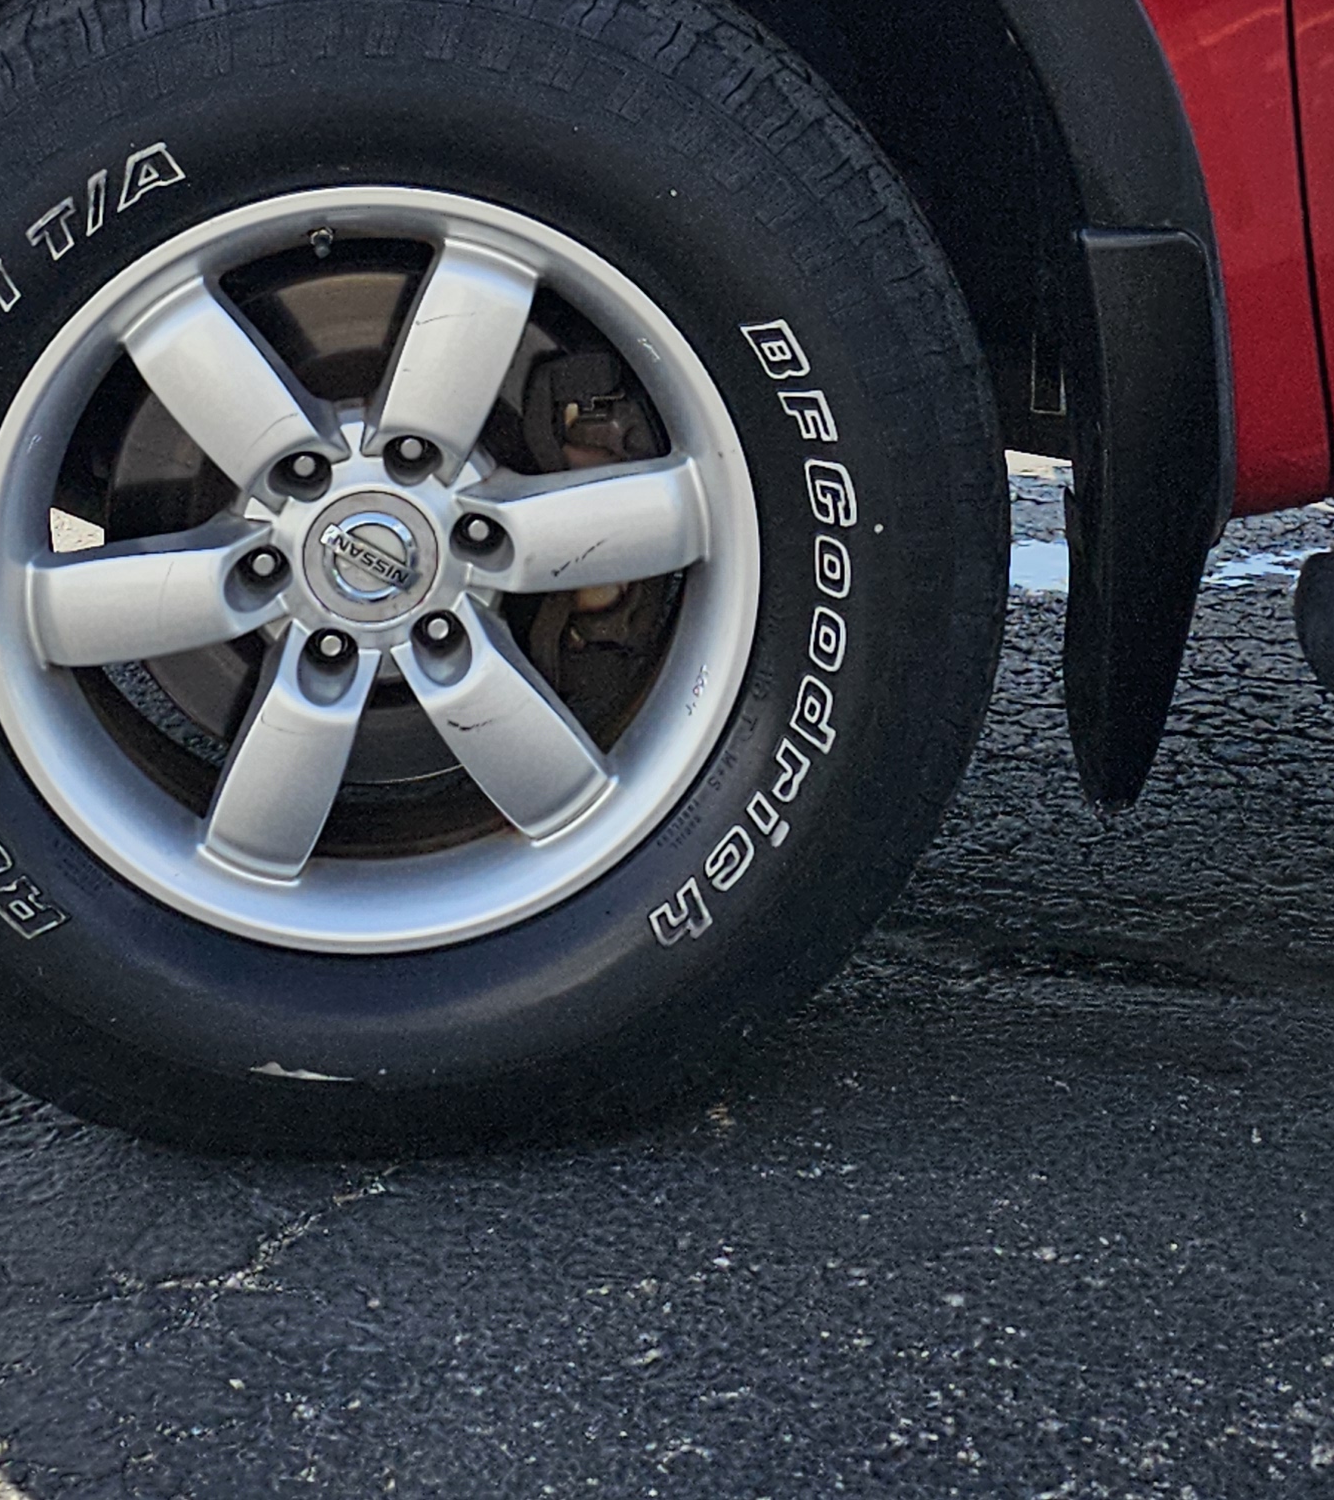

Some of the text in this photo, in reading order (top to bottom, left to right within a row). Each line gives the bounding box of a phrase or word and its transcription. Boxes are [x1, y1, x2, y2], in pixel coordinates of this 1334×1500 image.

[25, 141, 187, 263] T/A
[331, 533, 409, 586] NISSAN
[648, 318, 856, 948] BFGoodrich
